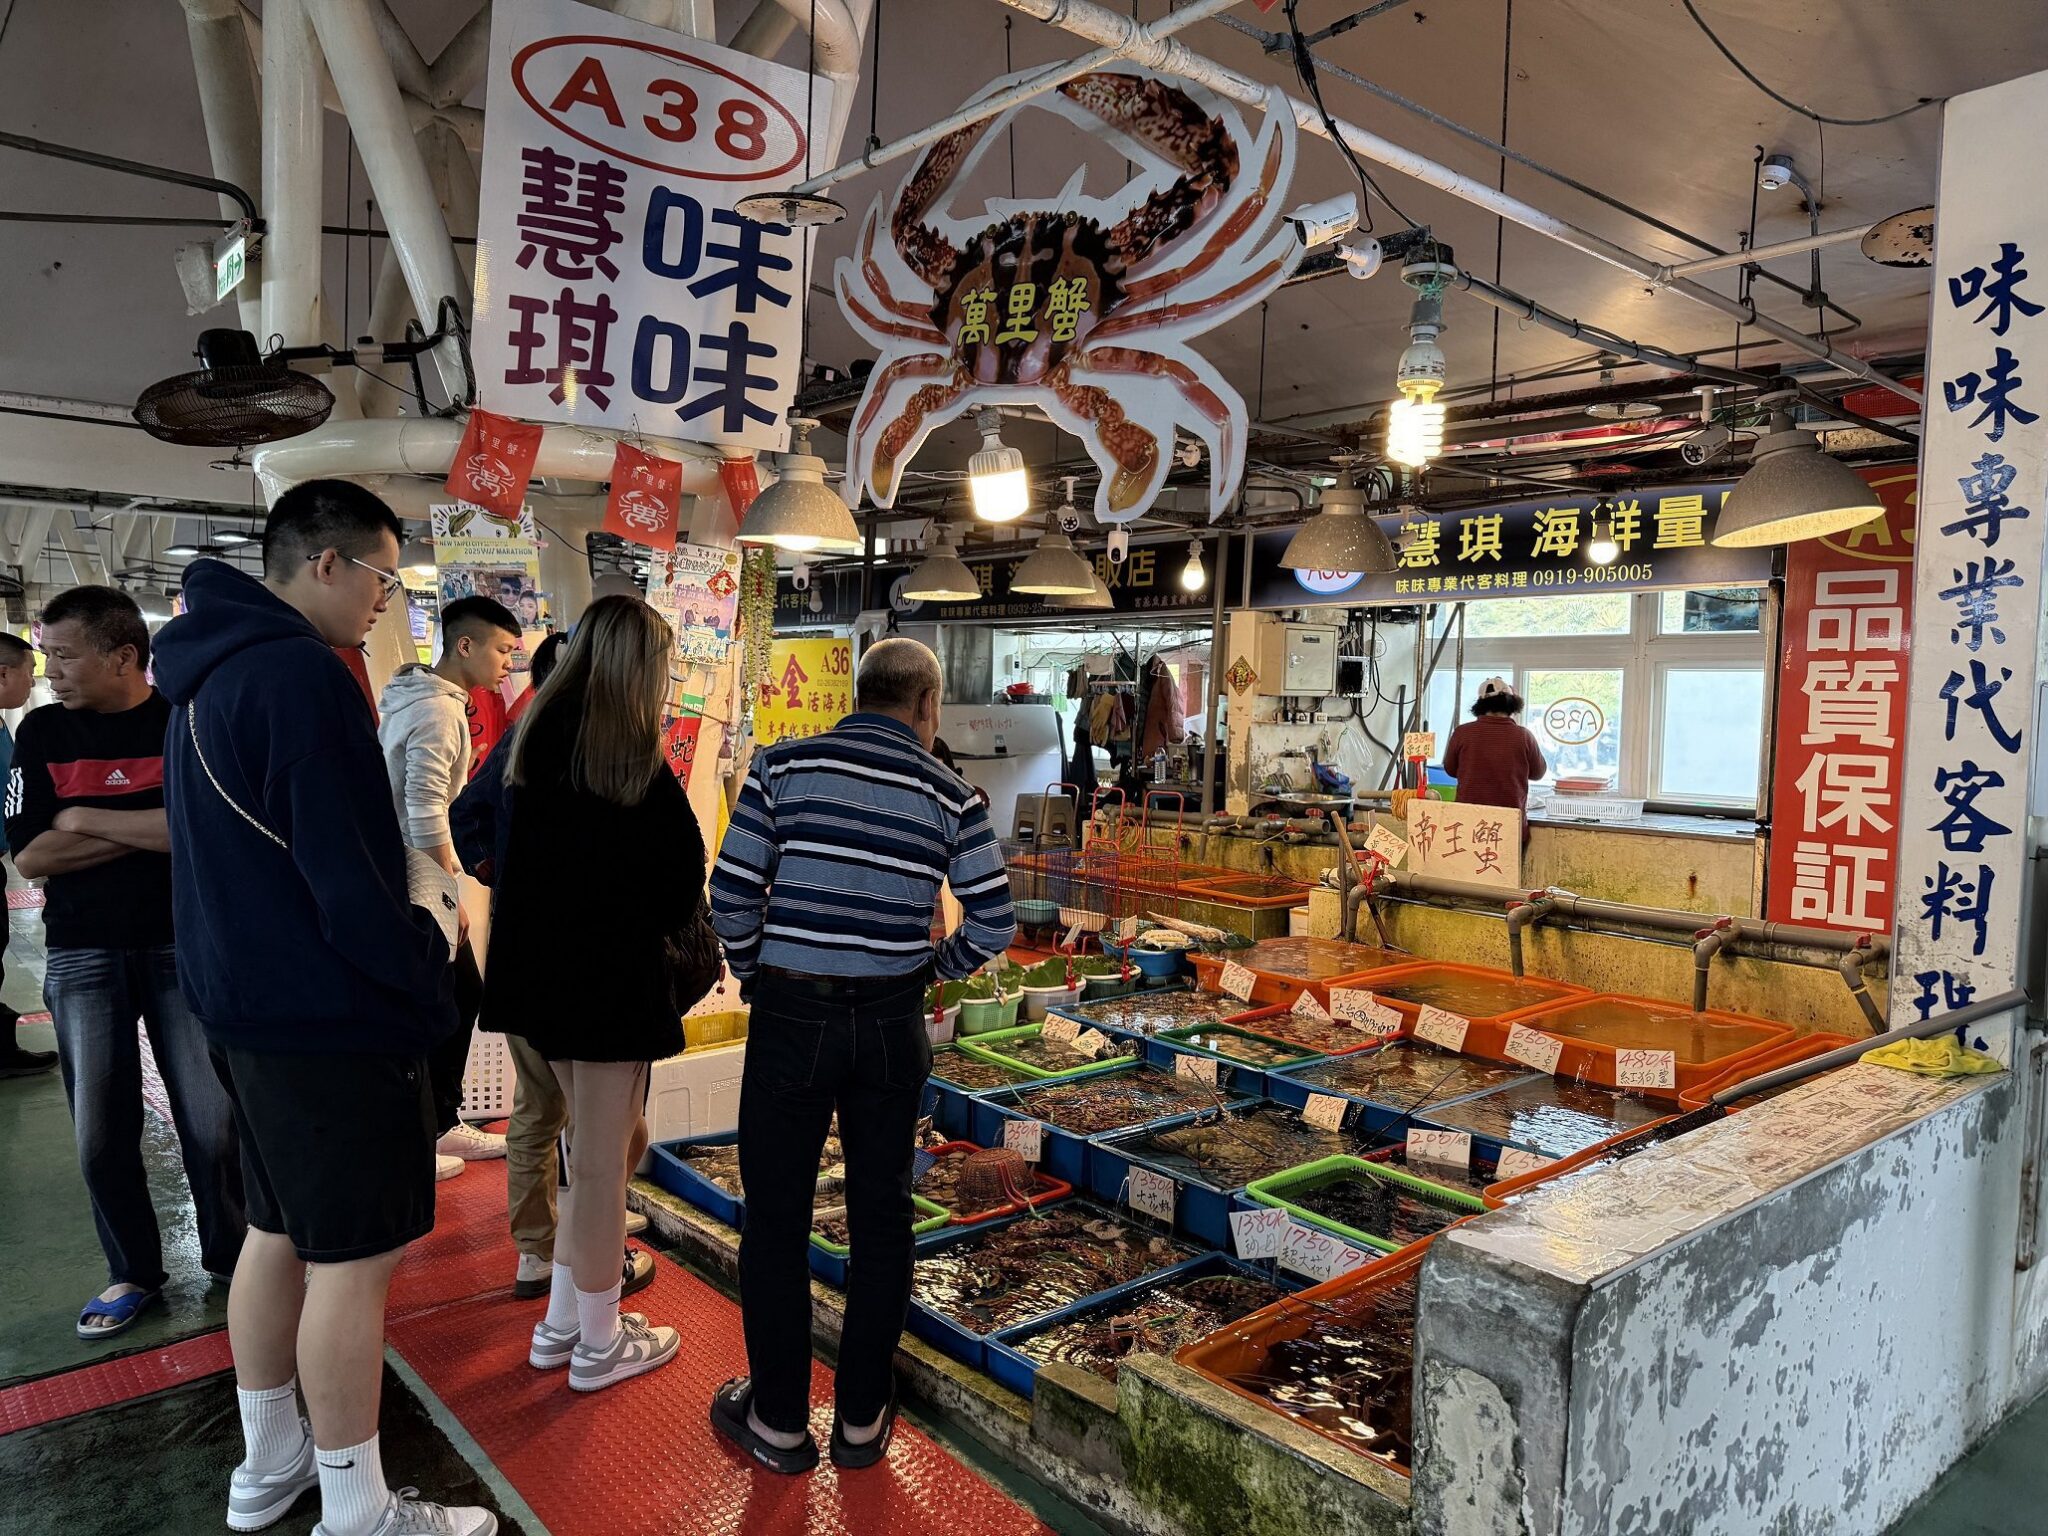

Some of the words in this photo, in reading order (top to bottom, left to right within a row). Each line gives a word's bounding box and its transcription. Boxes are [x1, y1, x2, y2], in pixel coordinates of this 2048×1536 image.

[549, 56, 769, 161] A38
[957, 276, 1091, 348] 萬里蟹
[496, 548, 533, 556] MARATHON
[1397, 513, 1504, 569] 慧琪
[1395, 570, 1528, 594] 味味專業代客料理
[1532, 563, 1653, 586] 0919-905005
[820, 646, 850, 675] A36
[1790, 568, 1904, 931] 品質保証
[104, 778, 131, 786] adidas
[1409, 810, 1504, 875] 帝王蟹
